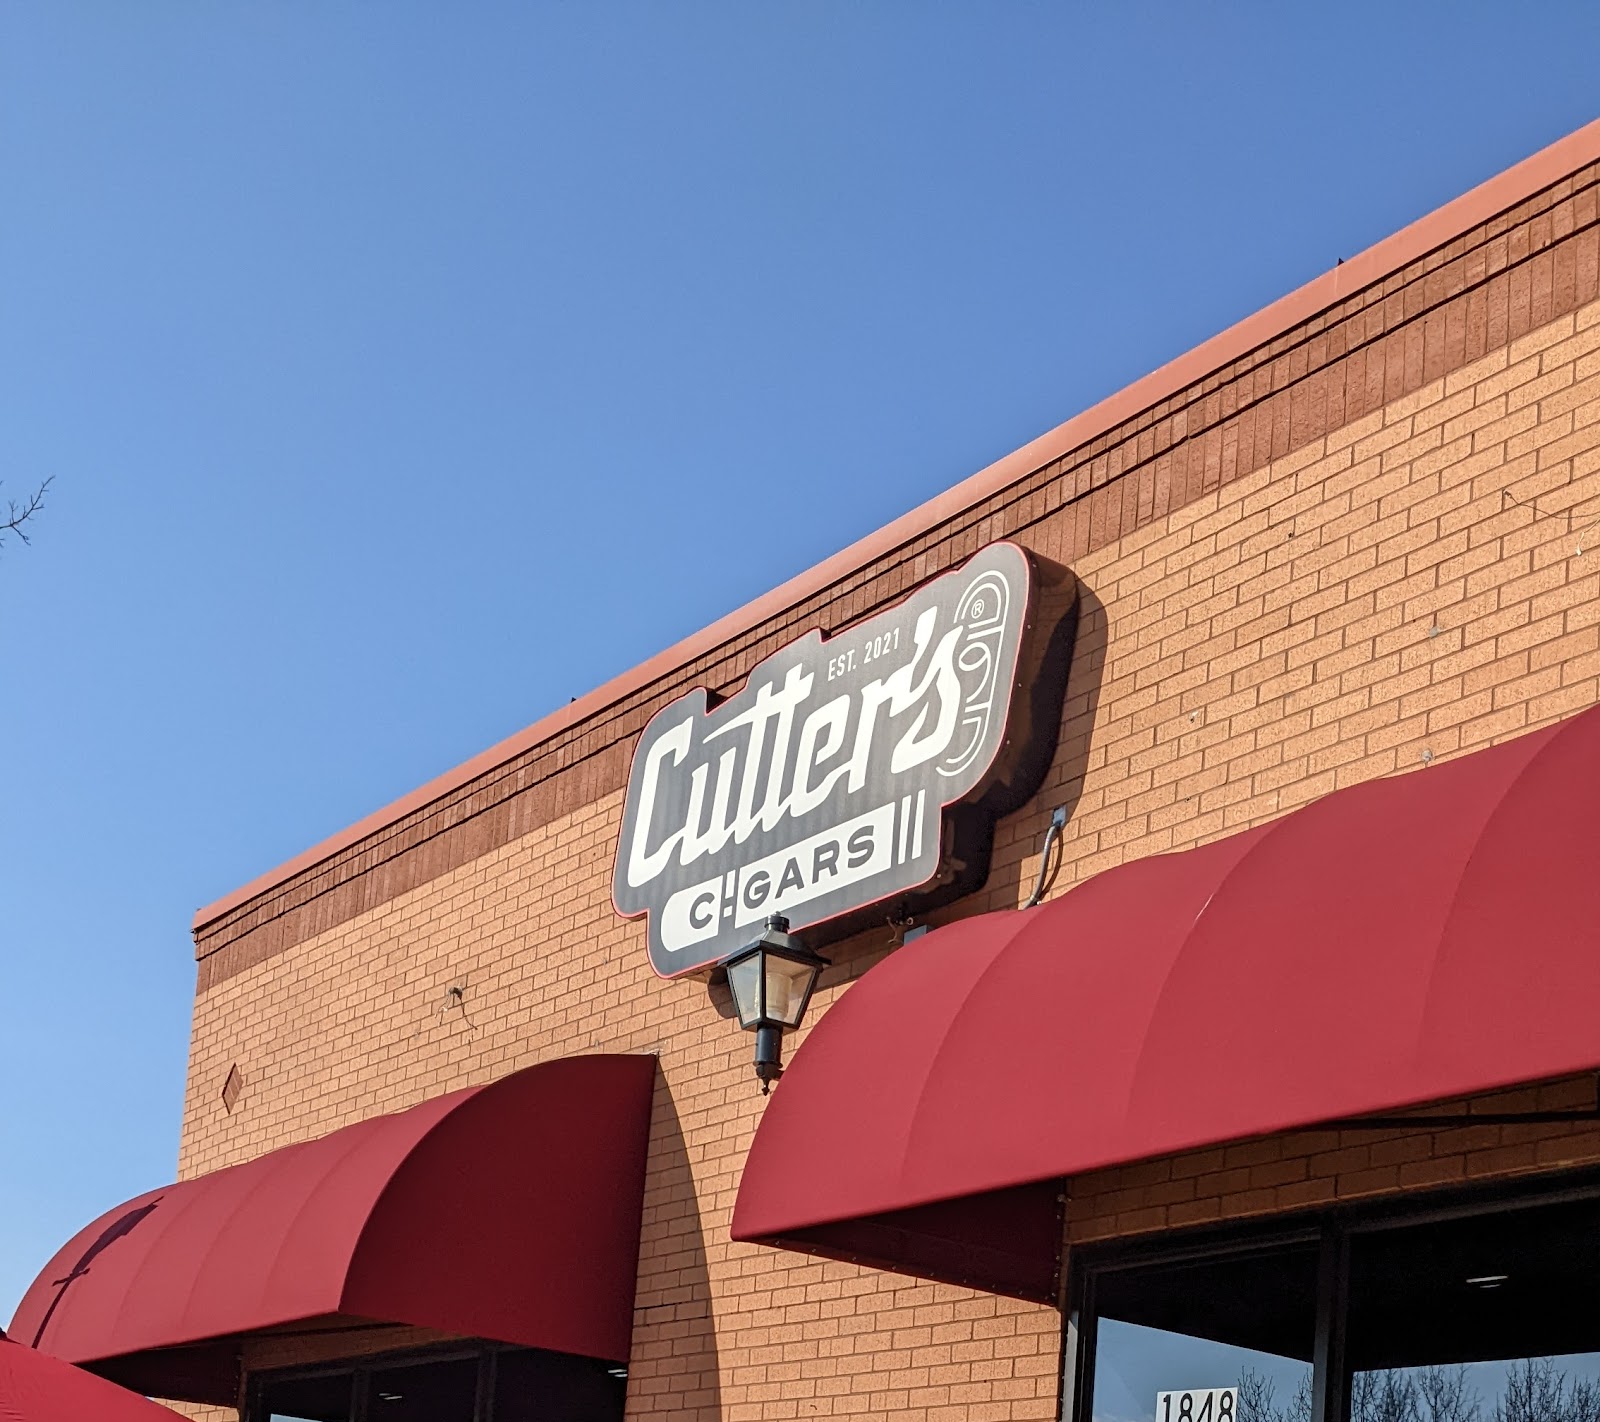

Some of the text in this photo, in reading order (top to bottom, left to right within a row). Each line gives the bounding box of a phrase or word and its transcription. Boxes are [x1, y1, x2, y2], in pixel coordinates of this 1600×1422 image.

[827, 627, 900, 683] EST. 2021
[627, 606, 964, 888] Cutter's
[688, 824, 876, 931] CIGARS
